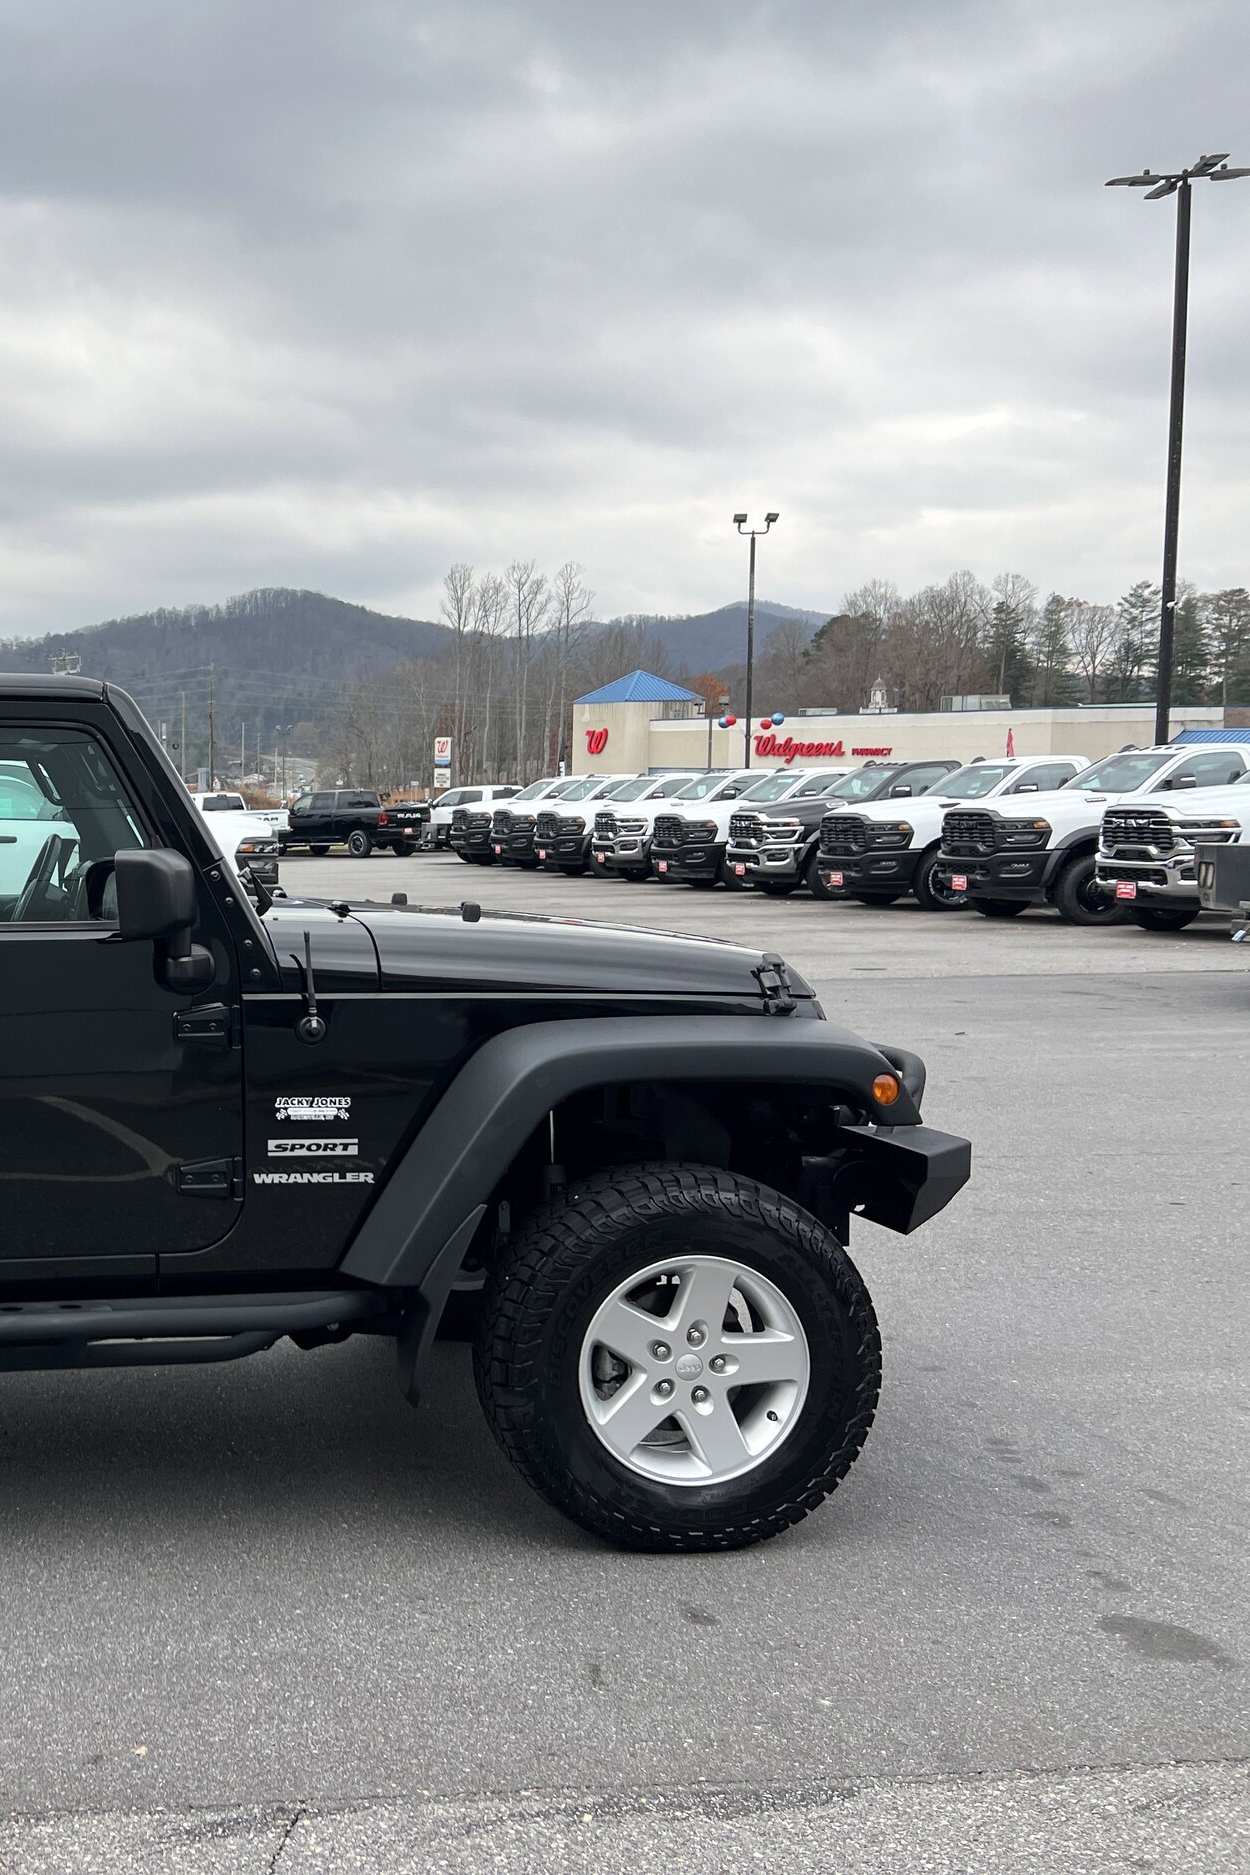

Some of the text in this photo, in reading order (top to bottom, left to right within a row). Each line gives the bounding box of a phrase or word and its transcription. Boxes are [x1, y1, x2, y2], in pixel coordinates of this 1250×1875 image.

[585, 728, 608, 754] W
[754, 734, 845, 764] Walgreens
[275, 1097, 351, 1107] JACKY JONES
[268, 1142, 358, 1153] SPORT
[253, 1172, 375, 1184] WRANGLER
